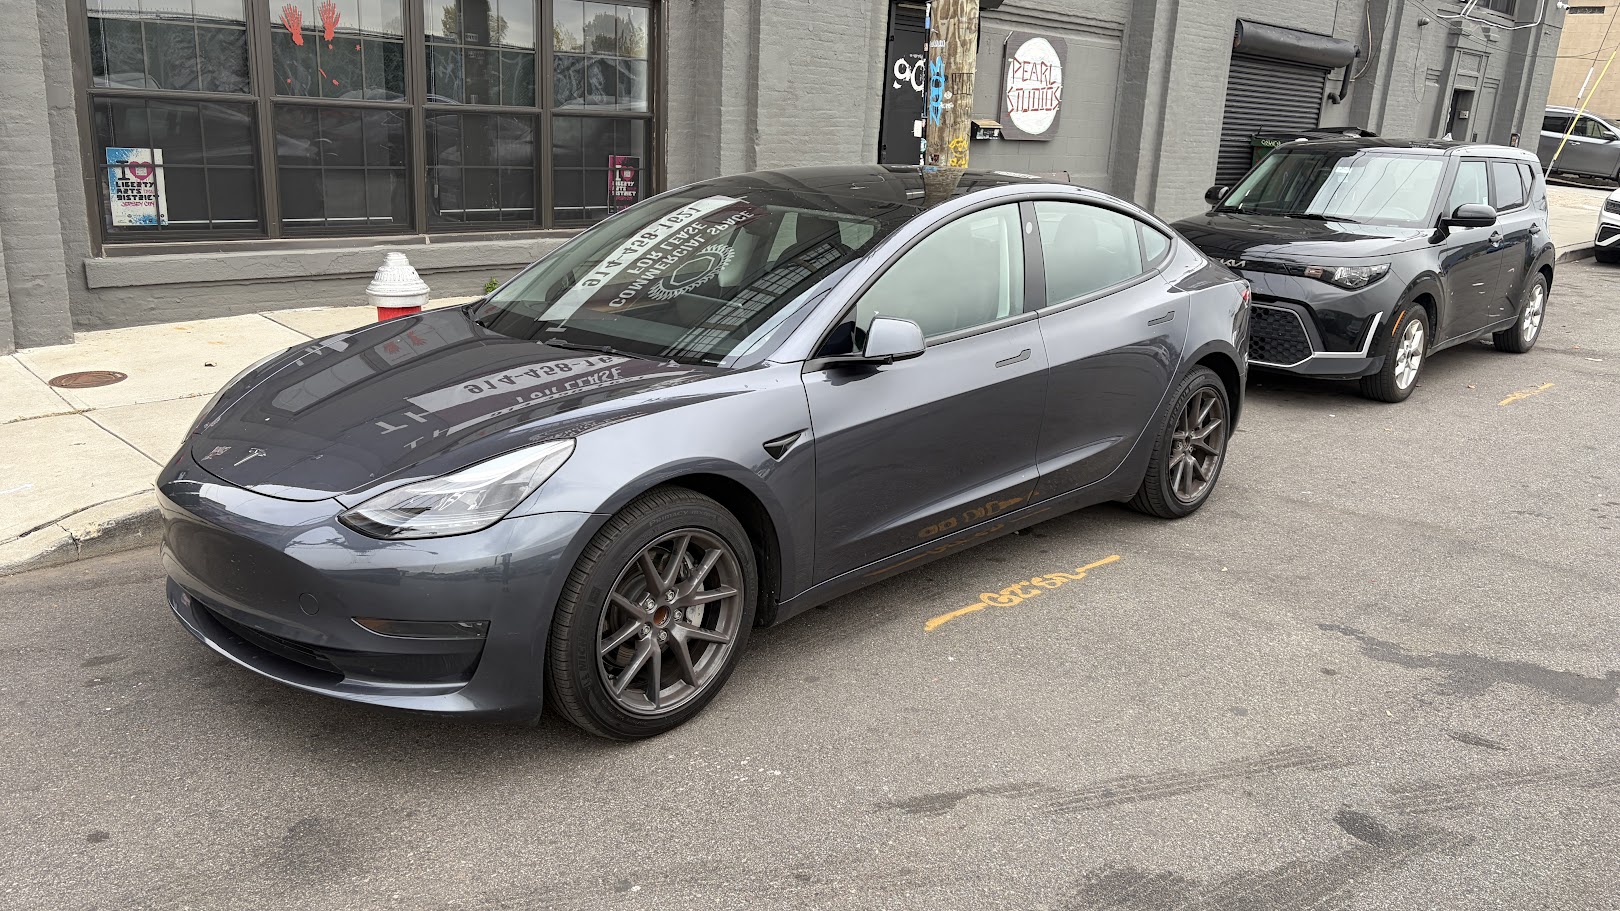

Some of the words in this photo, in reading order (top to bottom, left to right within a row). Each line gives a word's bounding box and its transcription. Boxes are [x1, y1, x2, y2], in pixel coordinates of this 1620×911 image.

[1012, 56, 1057, 86] PEARL
[1007, 86, 1062, 117] STUDIOS
[116, 160, 131, 180] I
